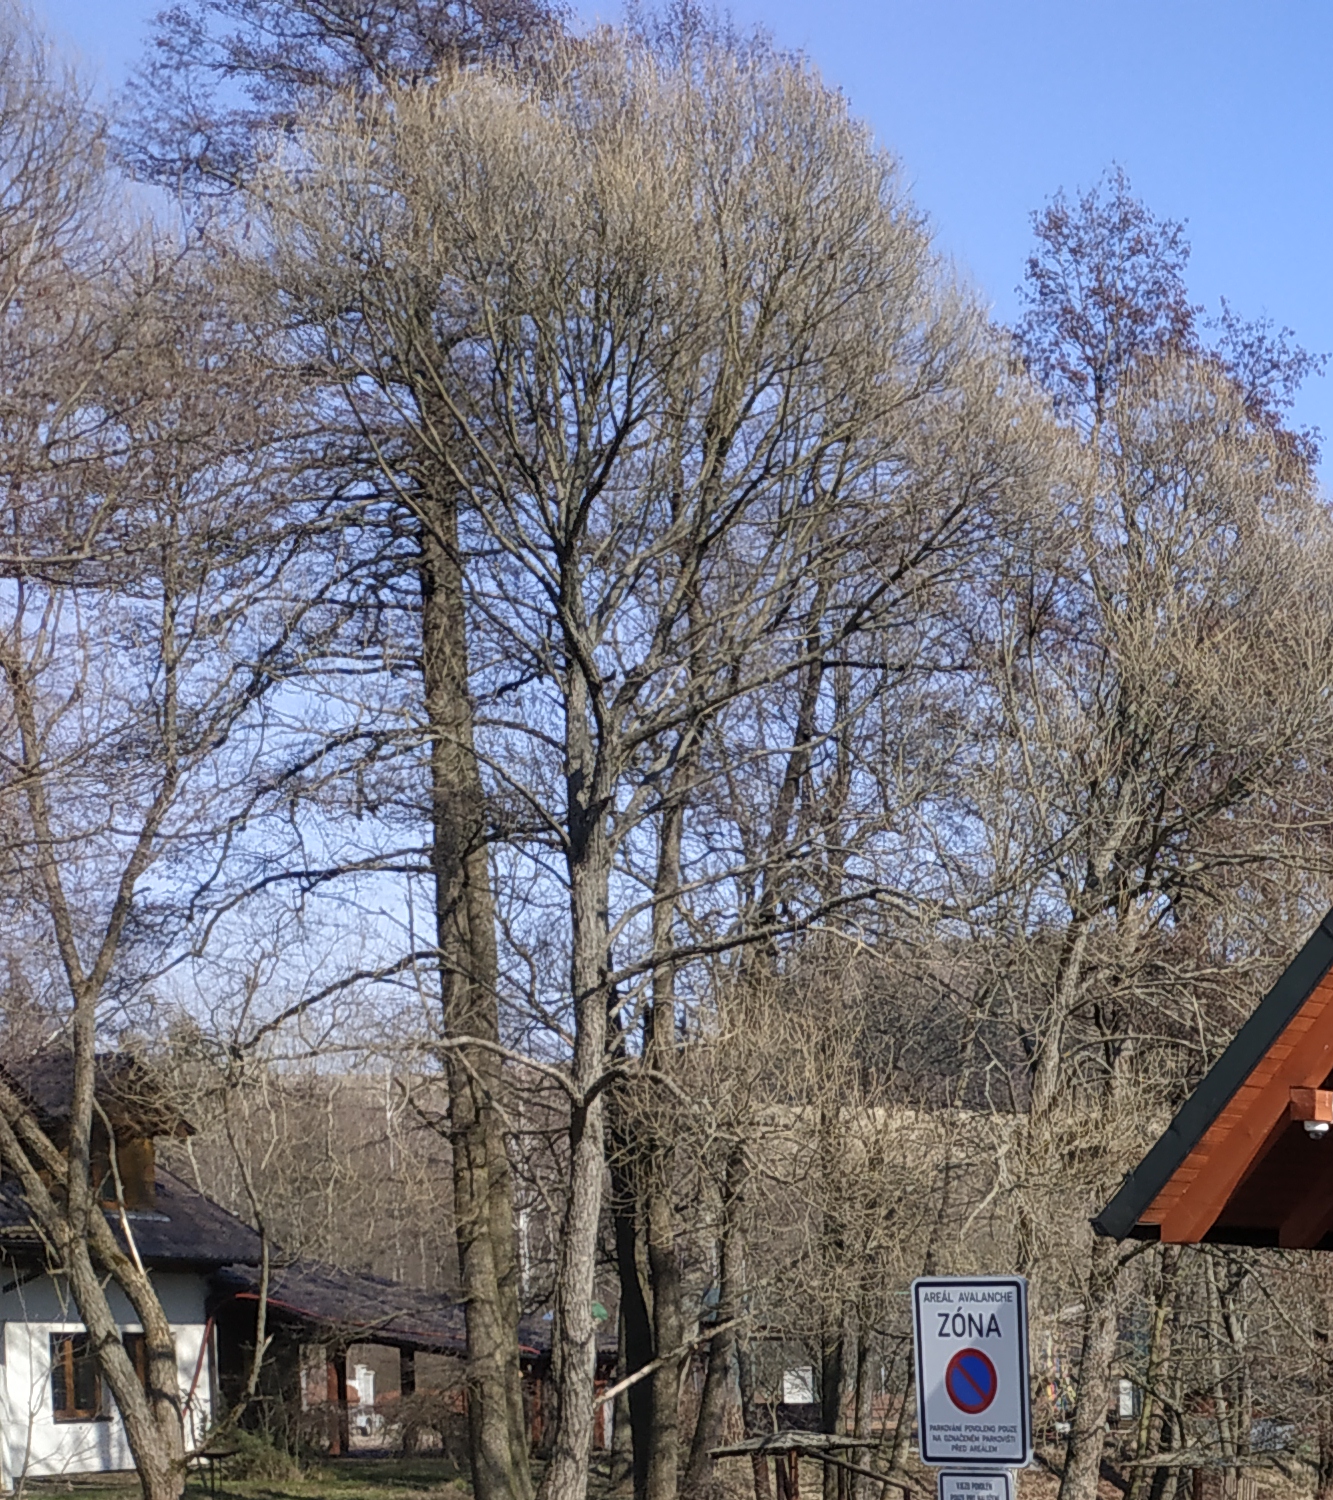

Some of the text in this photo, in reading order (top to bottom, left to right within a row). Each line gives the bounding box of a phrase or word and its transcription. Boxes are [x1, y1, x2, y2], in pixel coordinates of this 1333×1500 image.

[923, 1291, 1013, 1303] AREÁL AVALANCHE
[937, 1306, 1002, 1338] ZÓNA
